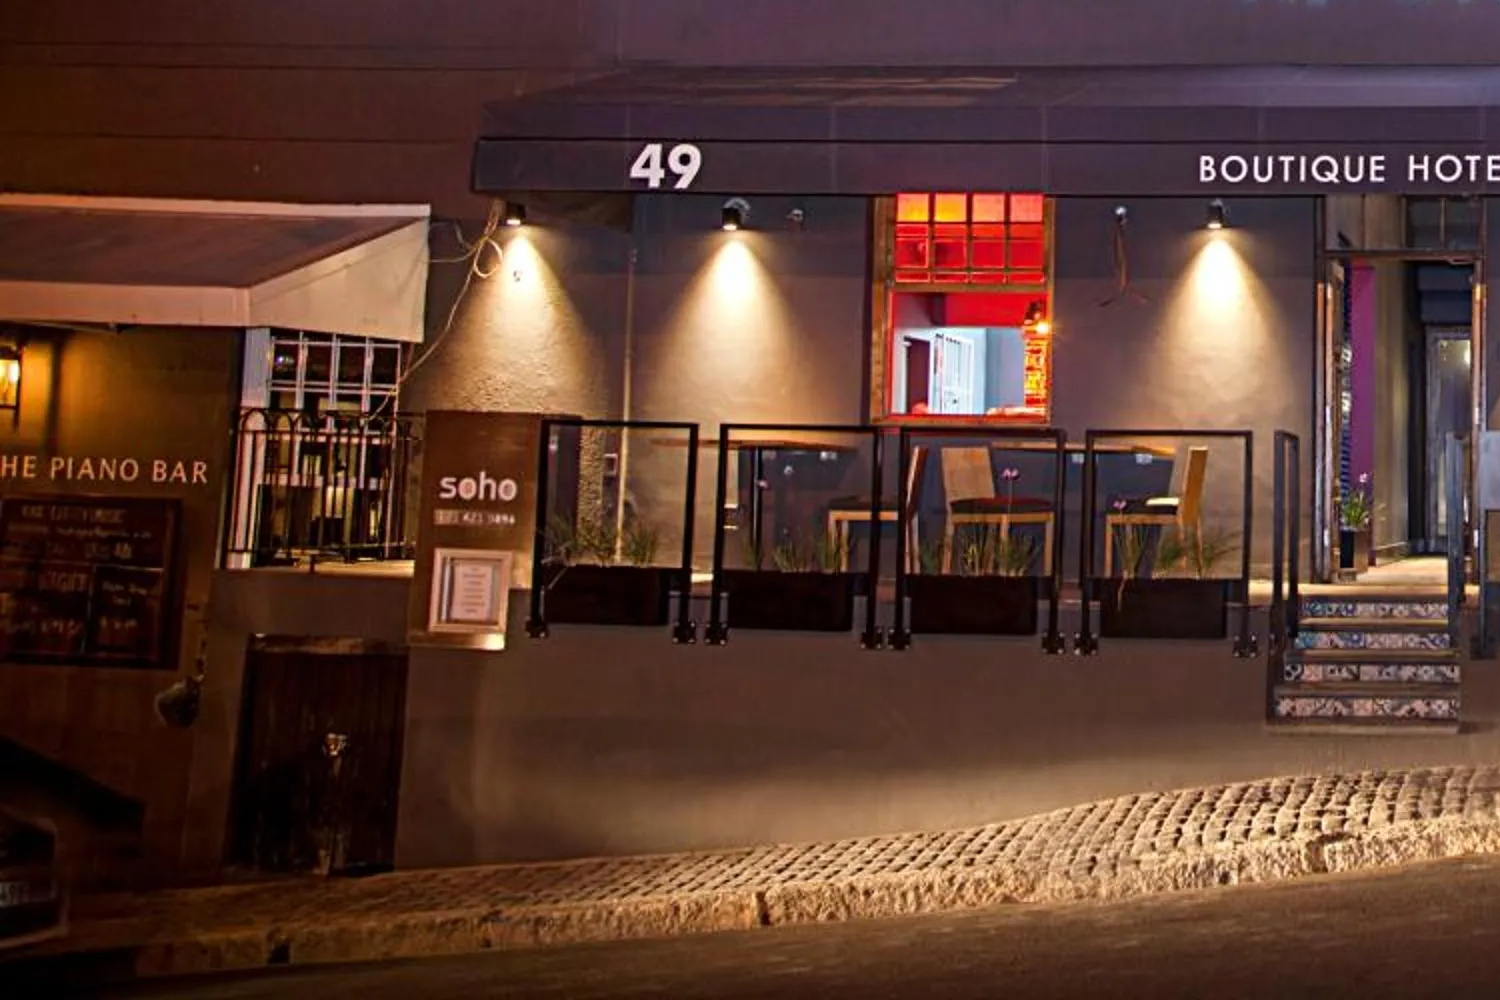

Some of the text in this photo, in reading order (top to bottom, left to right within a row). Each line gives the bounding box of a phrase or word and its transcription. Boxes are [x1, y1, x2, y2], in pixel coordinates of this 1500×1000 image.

[629, 143, 703, 190] 49
[1199, 155, 1386, 184] BOUTIQUE
[0, 455, 209, 484] HE PIANO BAR
[438, 471, 518, 501] soho
